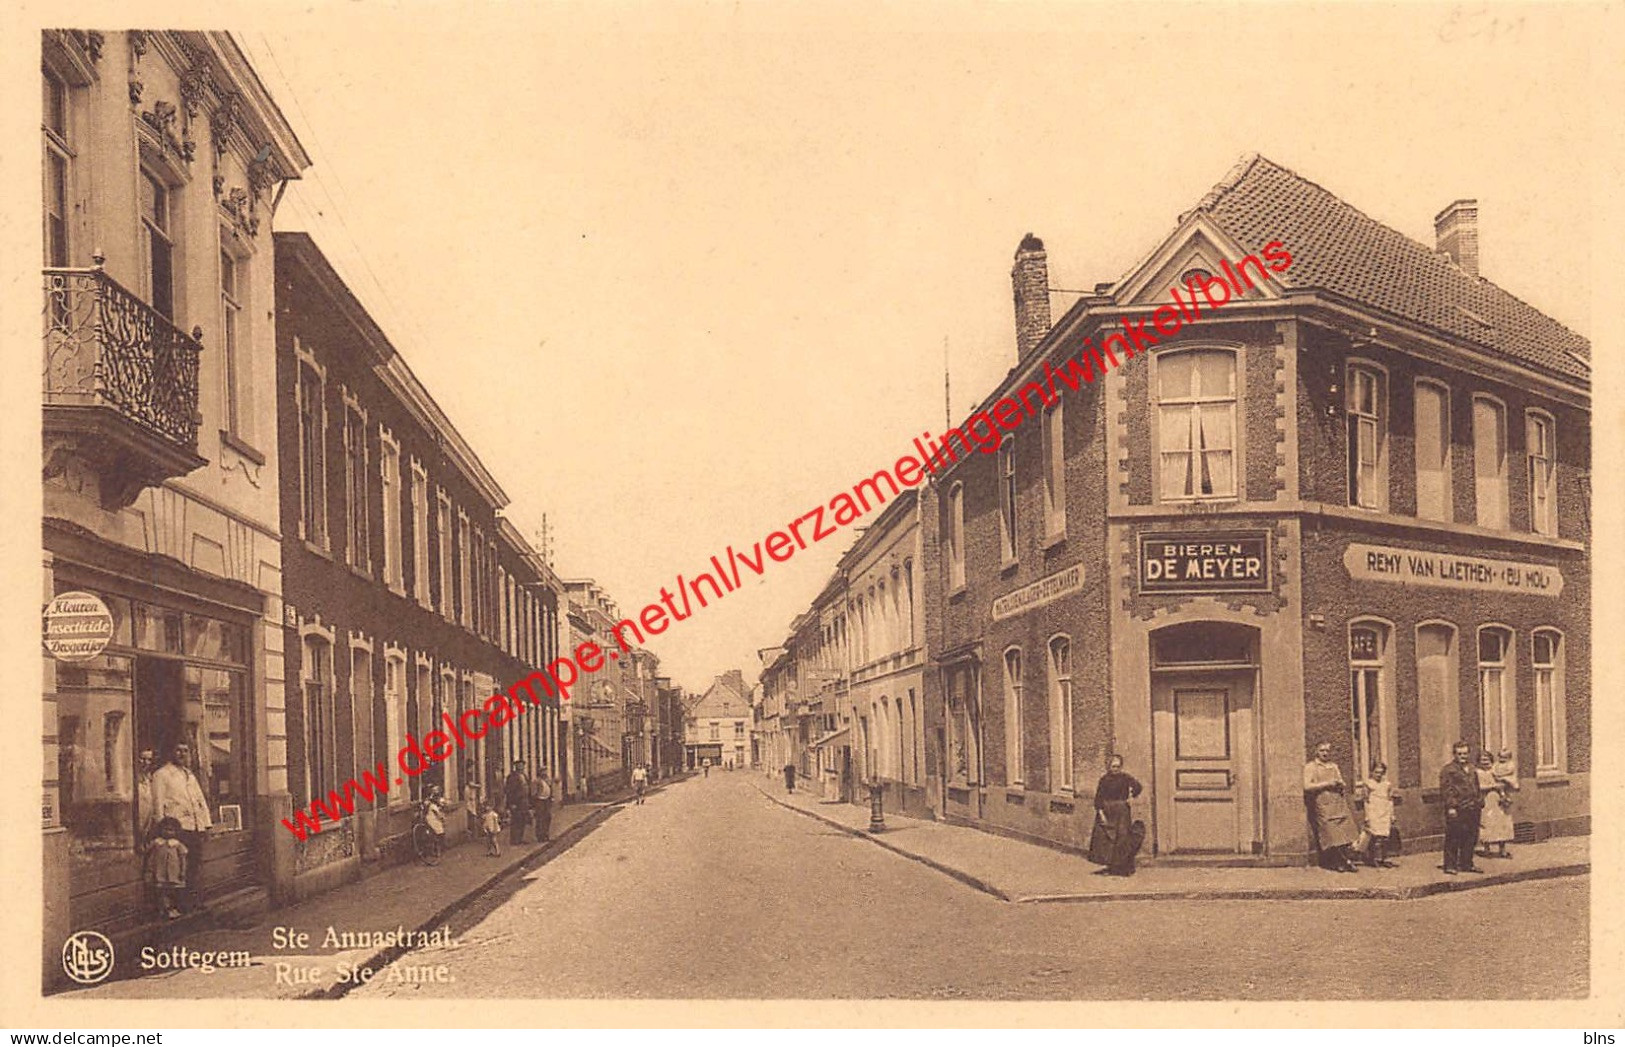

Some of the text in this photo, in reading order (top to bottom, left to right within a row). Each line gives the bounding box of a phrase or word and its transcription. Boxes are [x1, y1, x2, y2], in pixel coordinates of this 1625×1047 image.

[1164, 544, 1242, 557] BIEREN
[1147, 557, 1261, 580] DE MEYER
[1366, 551, 1401, 574] REMY
[1407, 555, 1435, 578] VAN
